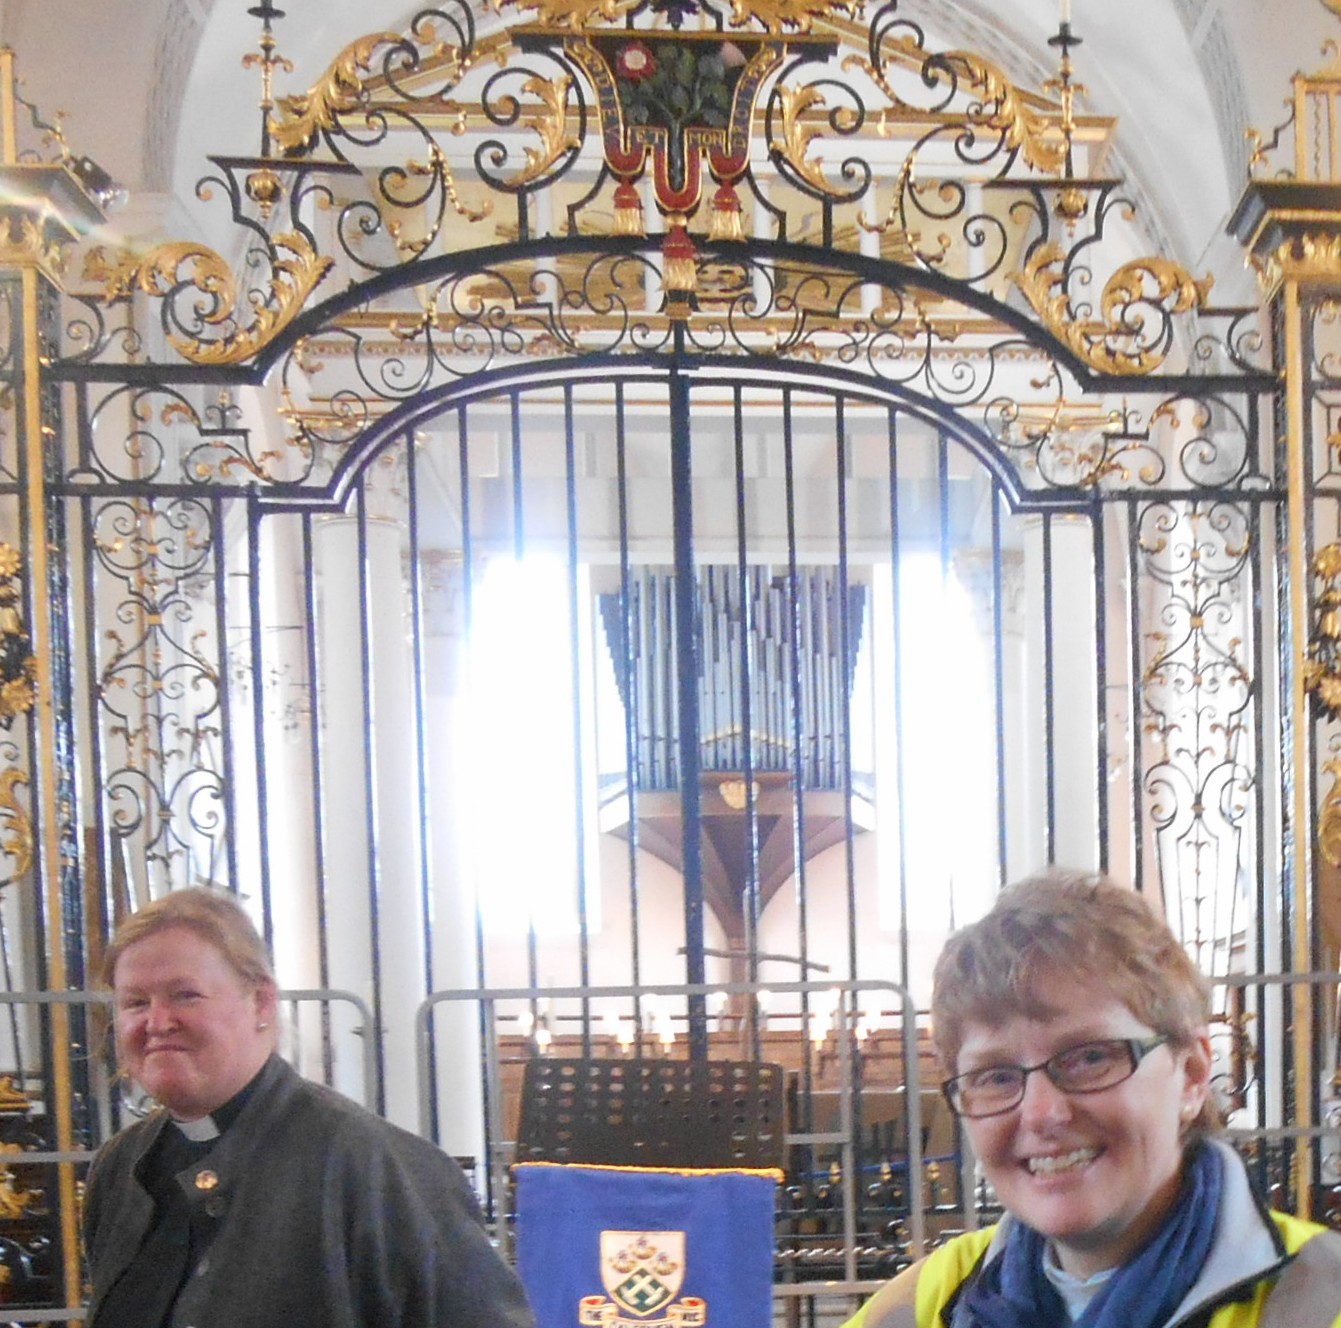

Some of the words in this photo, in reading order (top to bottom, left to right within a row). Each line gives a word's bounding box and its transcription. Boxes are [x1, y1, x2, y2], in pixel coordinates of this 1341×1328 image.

[636, 129, 664, 144] ET
[688, 131, 724, 146] MON
[586, 1310, 602, 1321] THE
